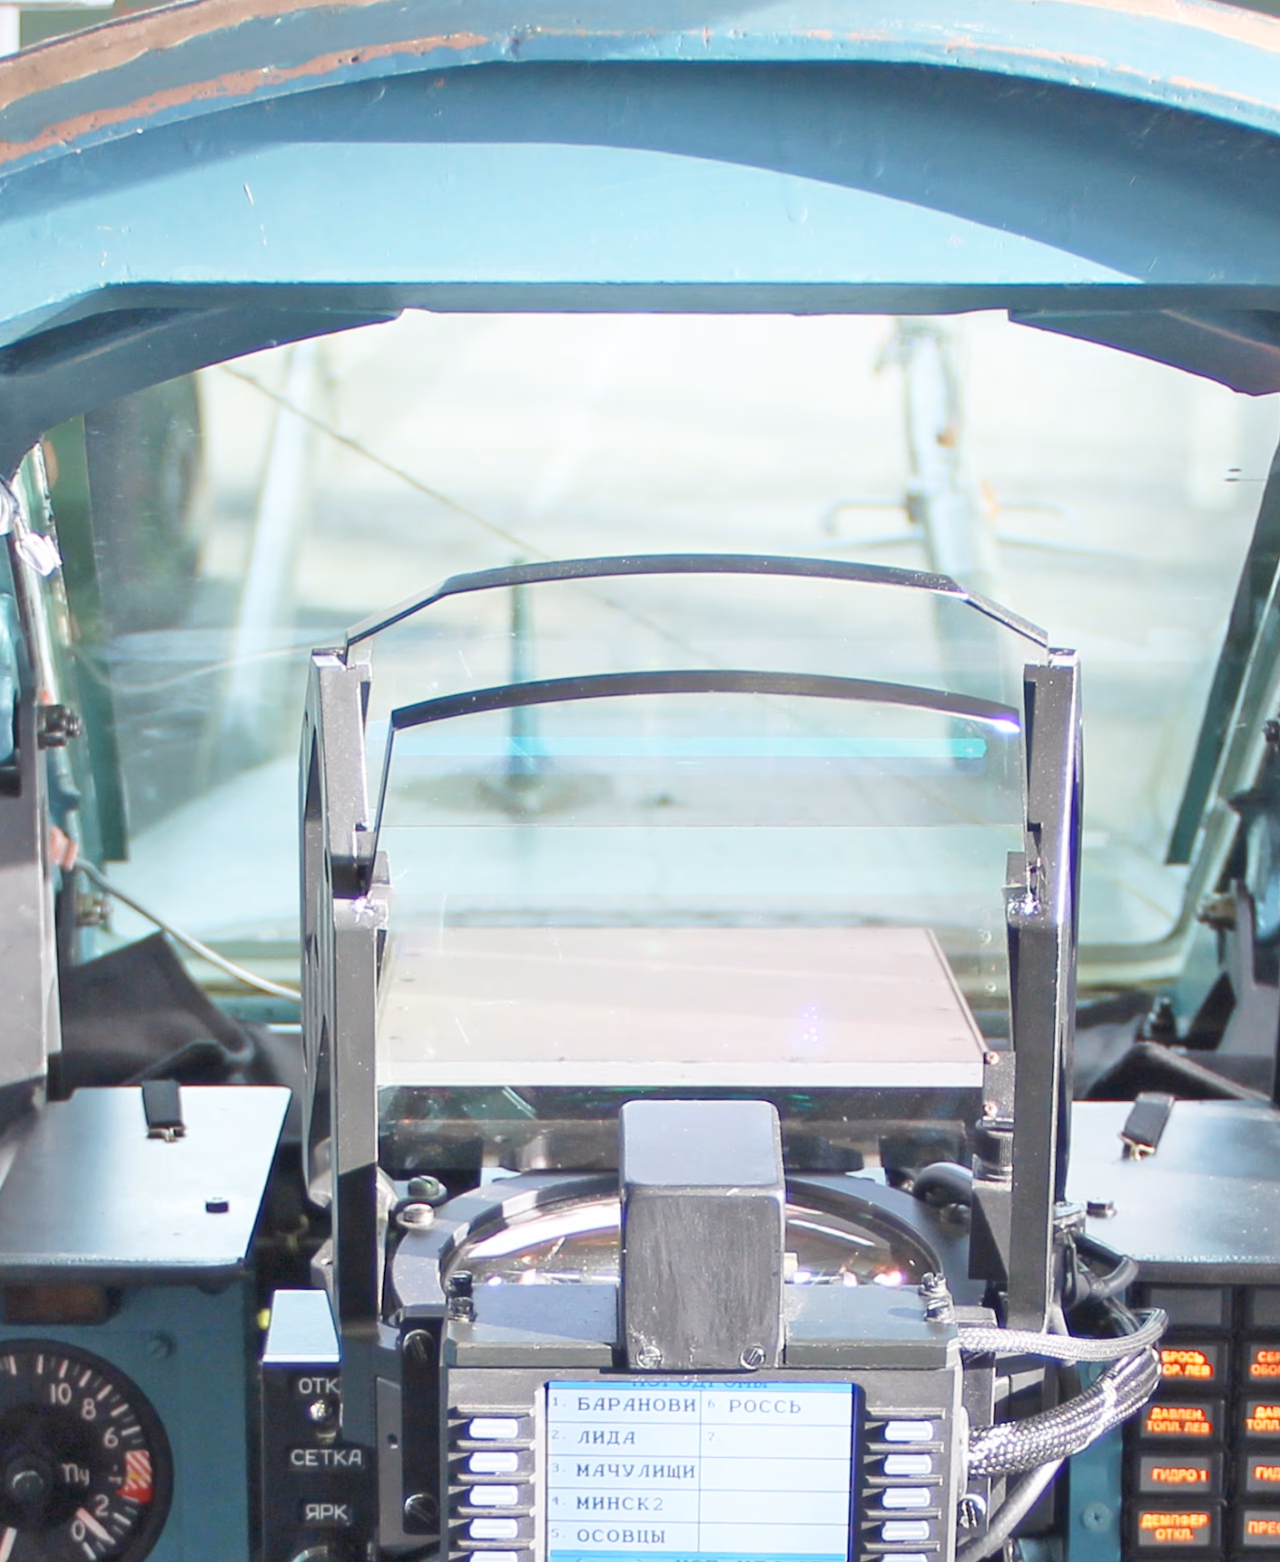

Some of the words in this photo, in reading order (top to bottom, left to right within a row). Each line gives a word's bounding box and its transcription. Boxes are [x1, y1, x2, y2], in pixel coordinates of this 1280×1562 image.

[1184, 1364, 1214, 1378] ЛЕВ
[298, 1377, 340, 1395] ОТК
[50, 1384, 72, 1404] 10
[80, 1398, 97, 1421] 8
[577, 1397, 697, 1413] БАРАНОВИ
[728, 1399, 802, 1414] РОССЬ
[1151, 1407, 1206, 1421] ДАВЛЕН.
[1146, 1419, 1181, 1433] ТОПЛ.
[1184, 1421, 1213, 1435] ЛЕВ
[103, 1427, 119, 1449] 6
[577, 1430, 636, 1445] ЛИДА
[291, 1448, 362, 1468] СЕТКА
[576, 1464, 696, 1480] МАЧУЛИЩИ
[1151, 1467, 1198, 1482] ГИДРО
[576, 1496, 664, 1511] МИНСК2
[305, 1503, 348, 1522] ЯРК
[1141, 1513, 1209, 1528] ДЕМПФЕР
[577, 1529, 666, 1544] ОСОВЦЫ
[1155, 1527, 1194, 1541] ОТКЛ.
